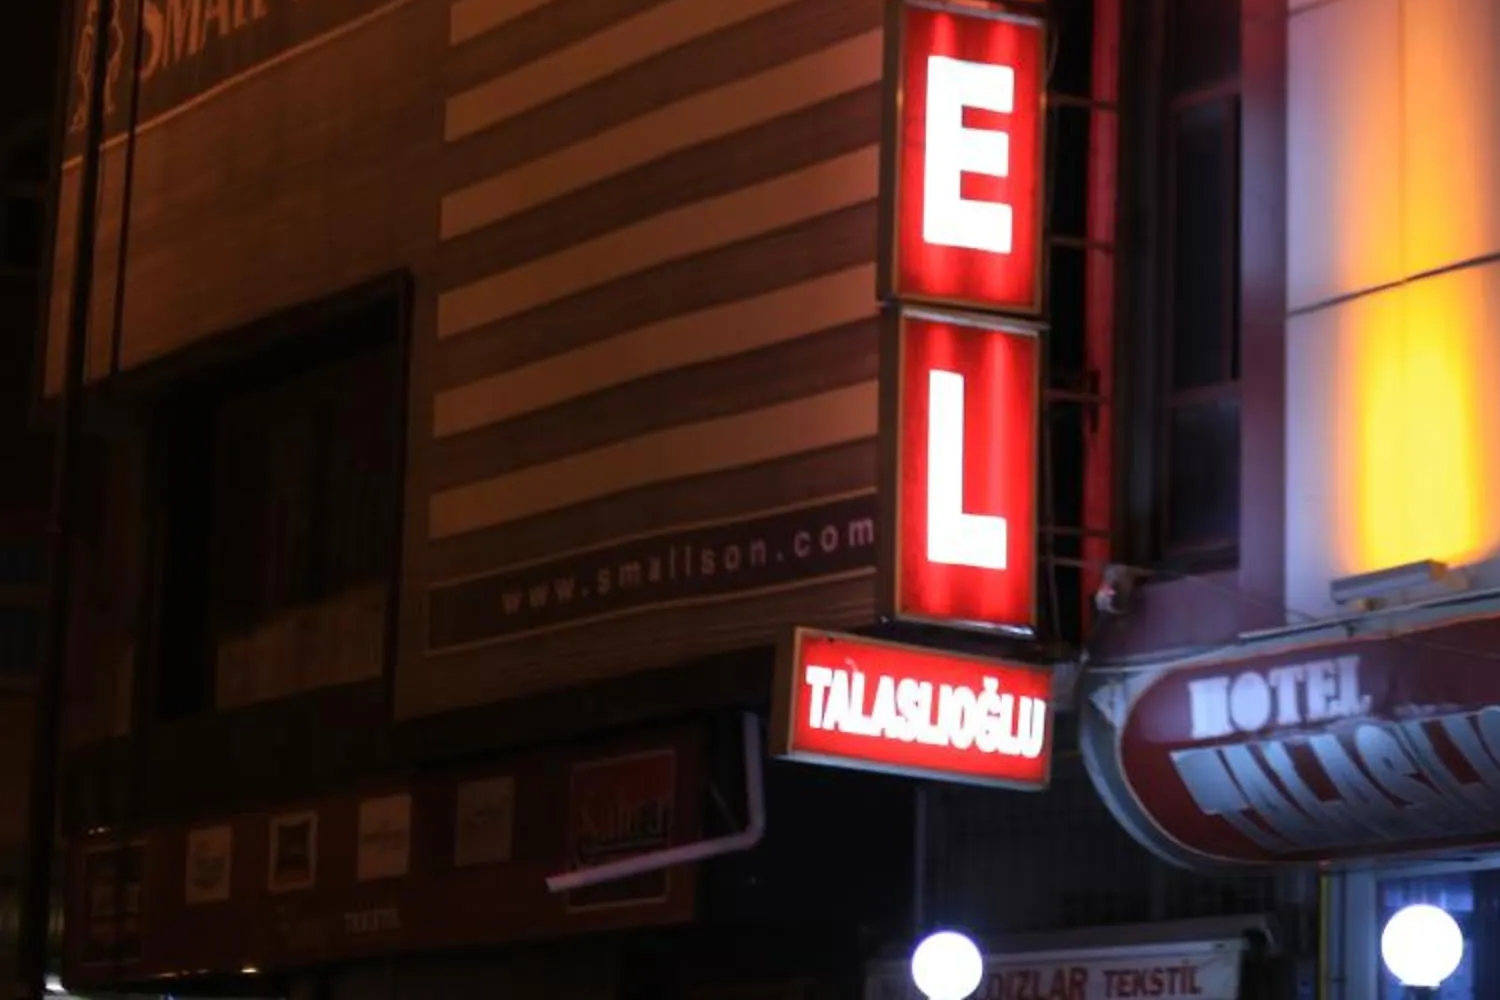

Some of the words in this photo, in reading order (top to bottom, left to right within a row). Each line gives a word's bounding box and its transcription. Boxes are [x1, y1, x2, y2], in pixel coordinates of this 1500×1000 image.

[500, 514, 875, 617] www.smallson.com
[804, 663, 1047, 759] TALASLIOĞLU
[1187, 653, 1374, 741] HOTEL
[1102, 959, 1203, 998] TEKSTİL
